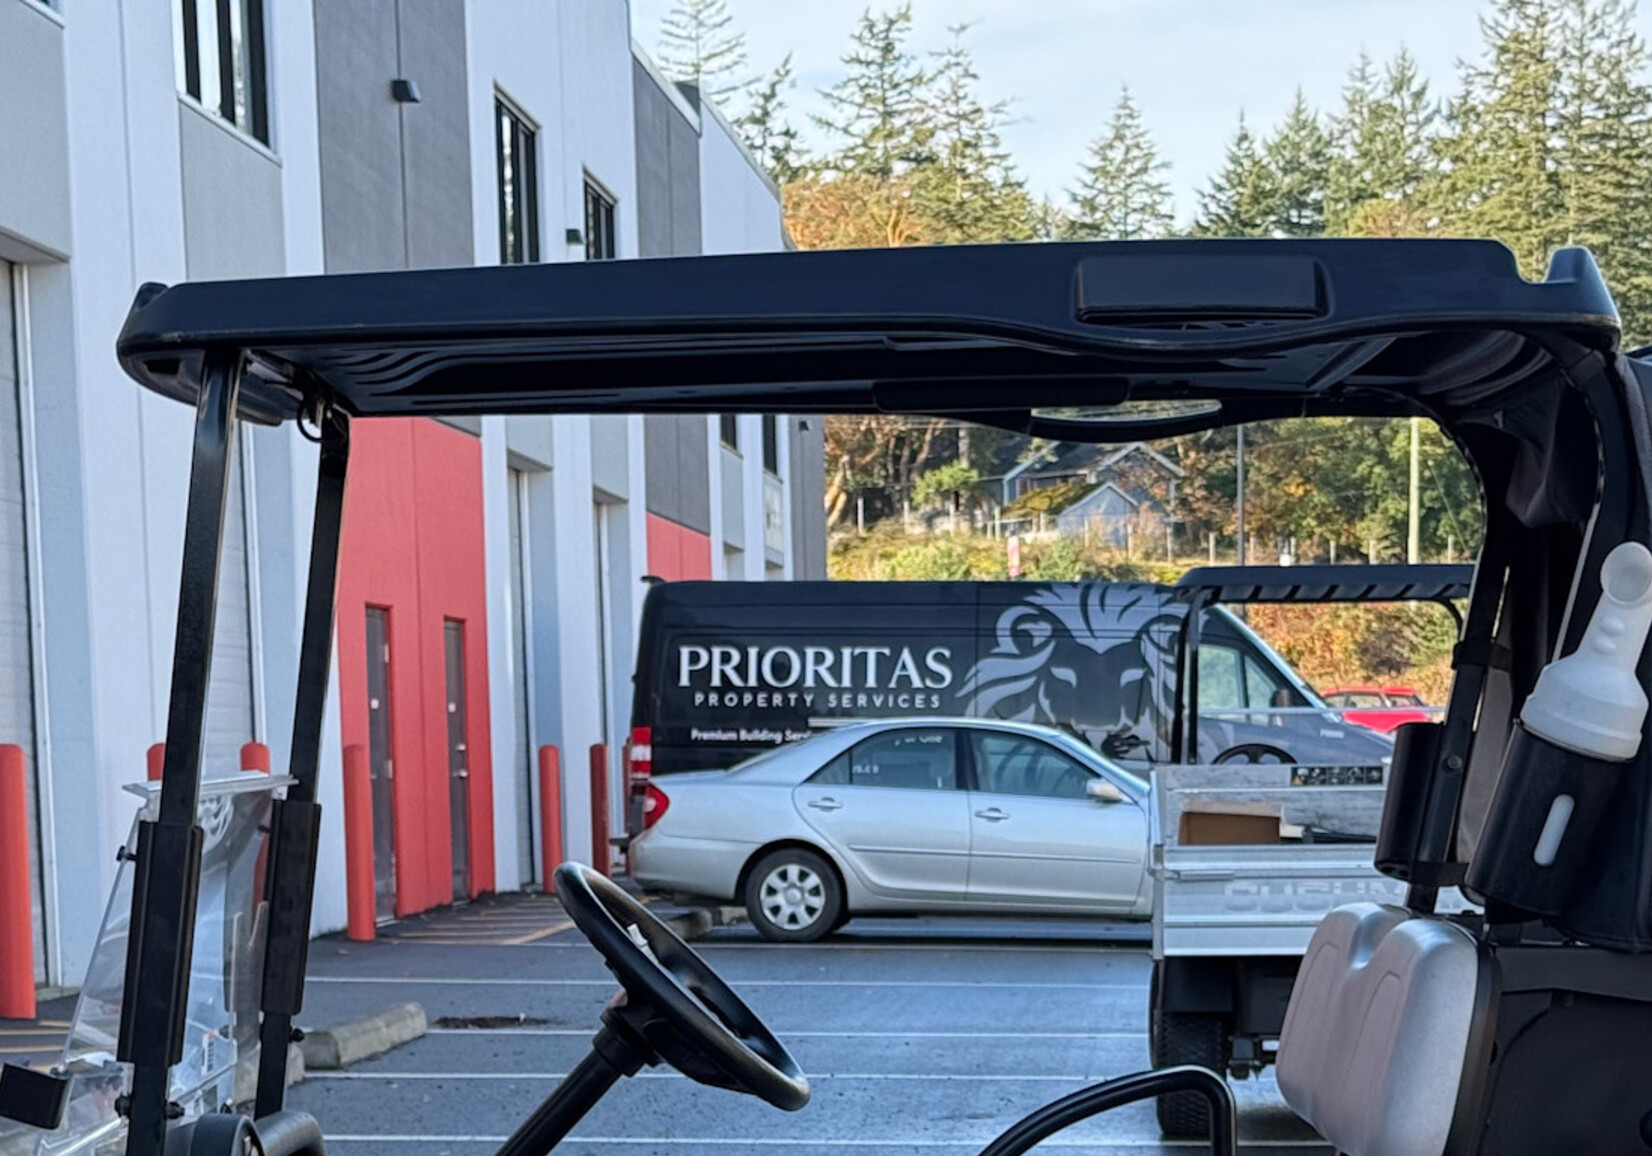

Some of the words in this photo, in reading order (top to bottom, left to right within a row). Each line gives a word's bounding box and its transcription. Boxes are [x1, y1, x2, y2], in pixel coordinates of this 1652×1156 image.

[678, 646, 953, 689] PRIORITAS
[694, 693, 814, 707] PROPERTY
[828, 694, 941, 708] SERVICES
[691, 728, 738, 741] Premium
[739, 728, 783, 744] Building
